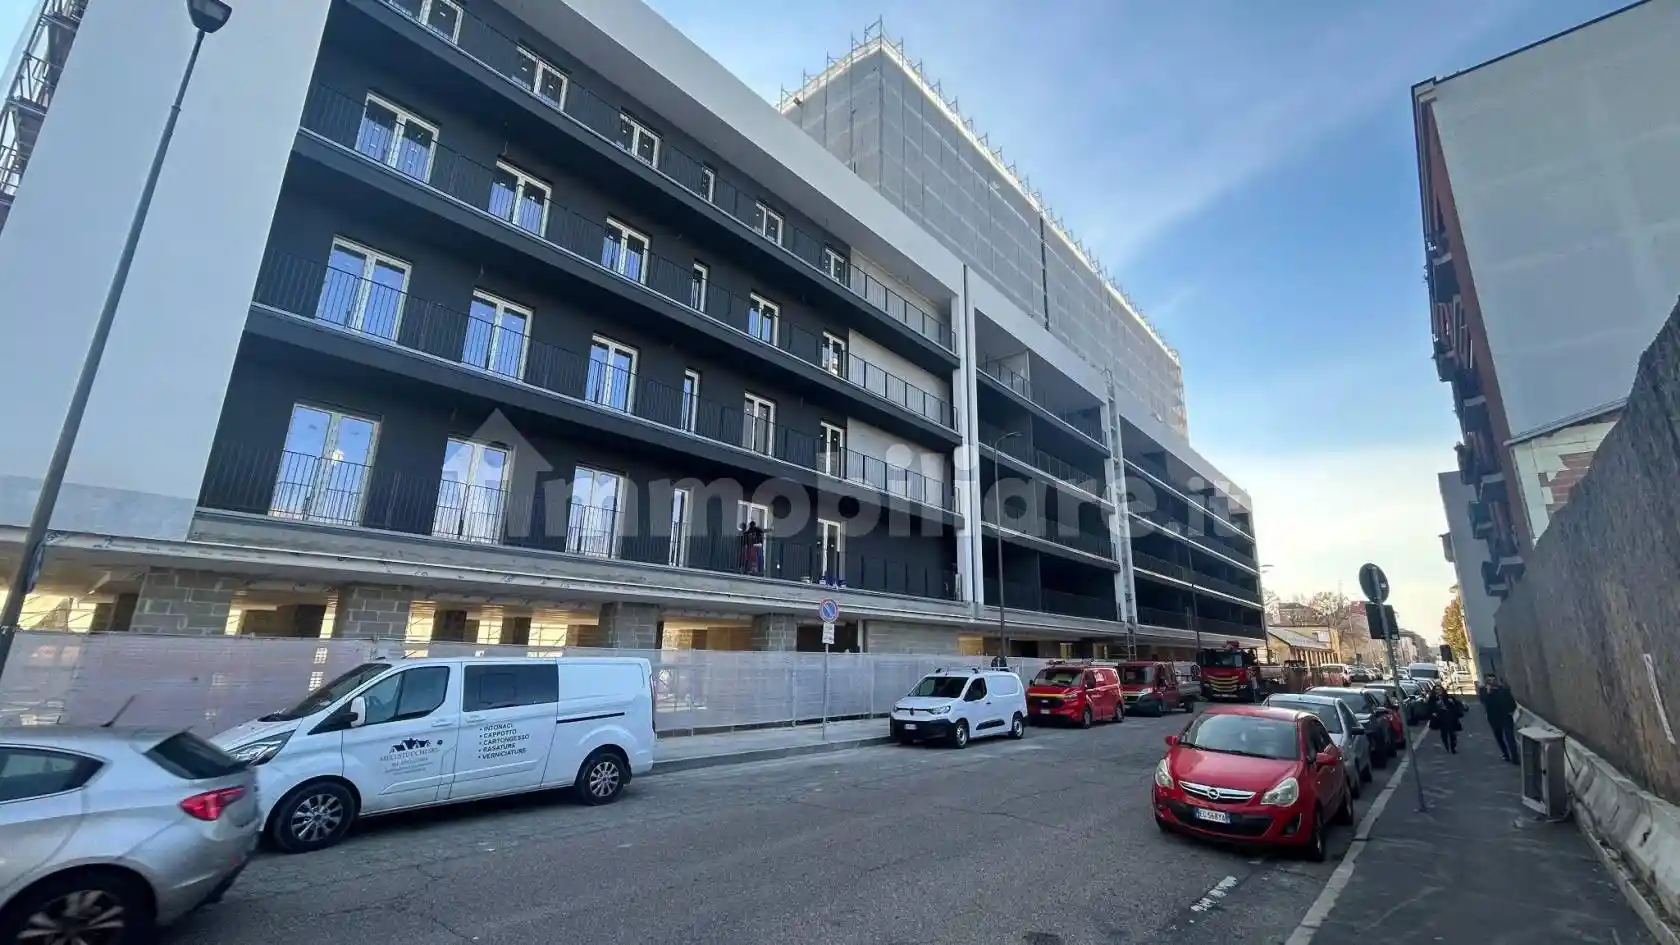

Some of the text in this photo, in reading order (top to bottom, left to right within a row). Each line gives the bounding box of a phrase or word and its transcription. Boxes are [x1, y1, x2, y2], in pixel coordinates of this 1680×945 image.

[483, 722, 513, 732] INTONACI
[483, 728, 517, 739] CAPPOTTO
[483, 733, 530, 746] CARTONGESSO
[482, 742, 517, 752] RASATURE
[482, 747, 528, 760] VERNICIATURE
